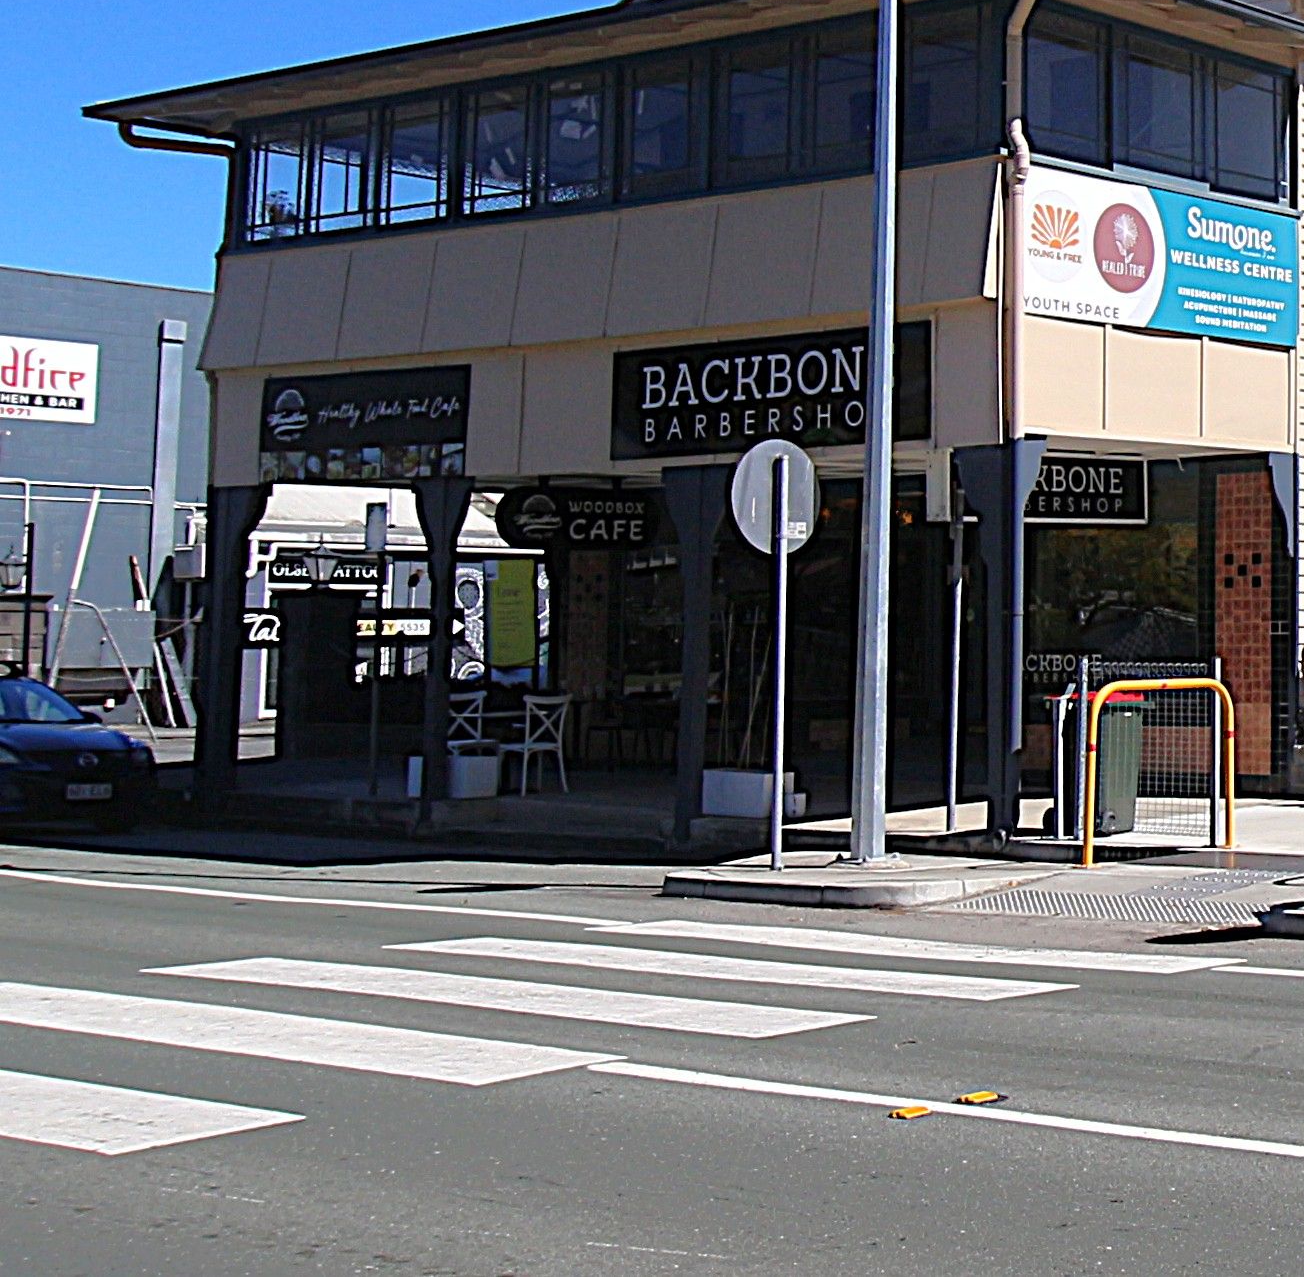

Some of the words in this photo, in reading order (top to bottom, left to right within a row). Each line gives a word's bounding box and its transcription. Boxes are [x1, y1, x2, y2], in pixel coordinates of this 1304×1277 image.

[1027, 247, 1054, 260] YOUNG
[1056, 252, 1061, 261] &
[1063, 253, 1083, 264] FREE
[1171, 248, 1240, 274] WELLNESS
[1243, 262, 1293, 283] CENTRE
[1023, 296, 1070, 312] YOUTH
[1076, 302, 1120, 319] SPACE
[1178, 286, 1227, 302] KINESIOLOGY
[1232, 294, 1285, 311] NATUROPATHY
[1184, 300, 1237, 316] ACUPUNCTURE
[1242, 308, 1277, 323] MASSAGE
[1195, 314, 1221, 328] SOUND
[1222, 318, 1267, 333] MEDITATION
[642, 346, 864, 409] BACKBON
[0, 407, 31, 416] 1971
[34, 396, 44, 405] &
[48, 397, 77, 408] BAR
[645, 401, 864, 442] BARBERSHO
[568, 500, 645, 515] WOODBOX
[569, 519, 644, 541] CAFE
[272, 563, 309, 577] OLSE
[333, 565, 378, 578] ATTO
[1022, 654, 1102, 671] CKBOE
